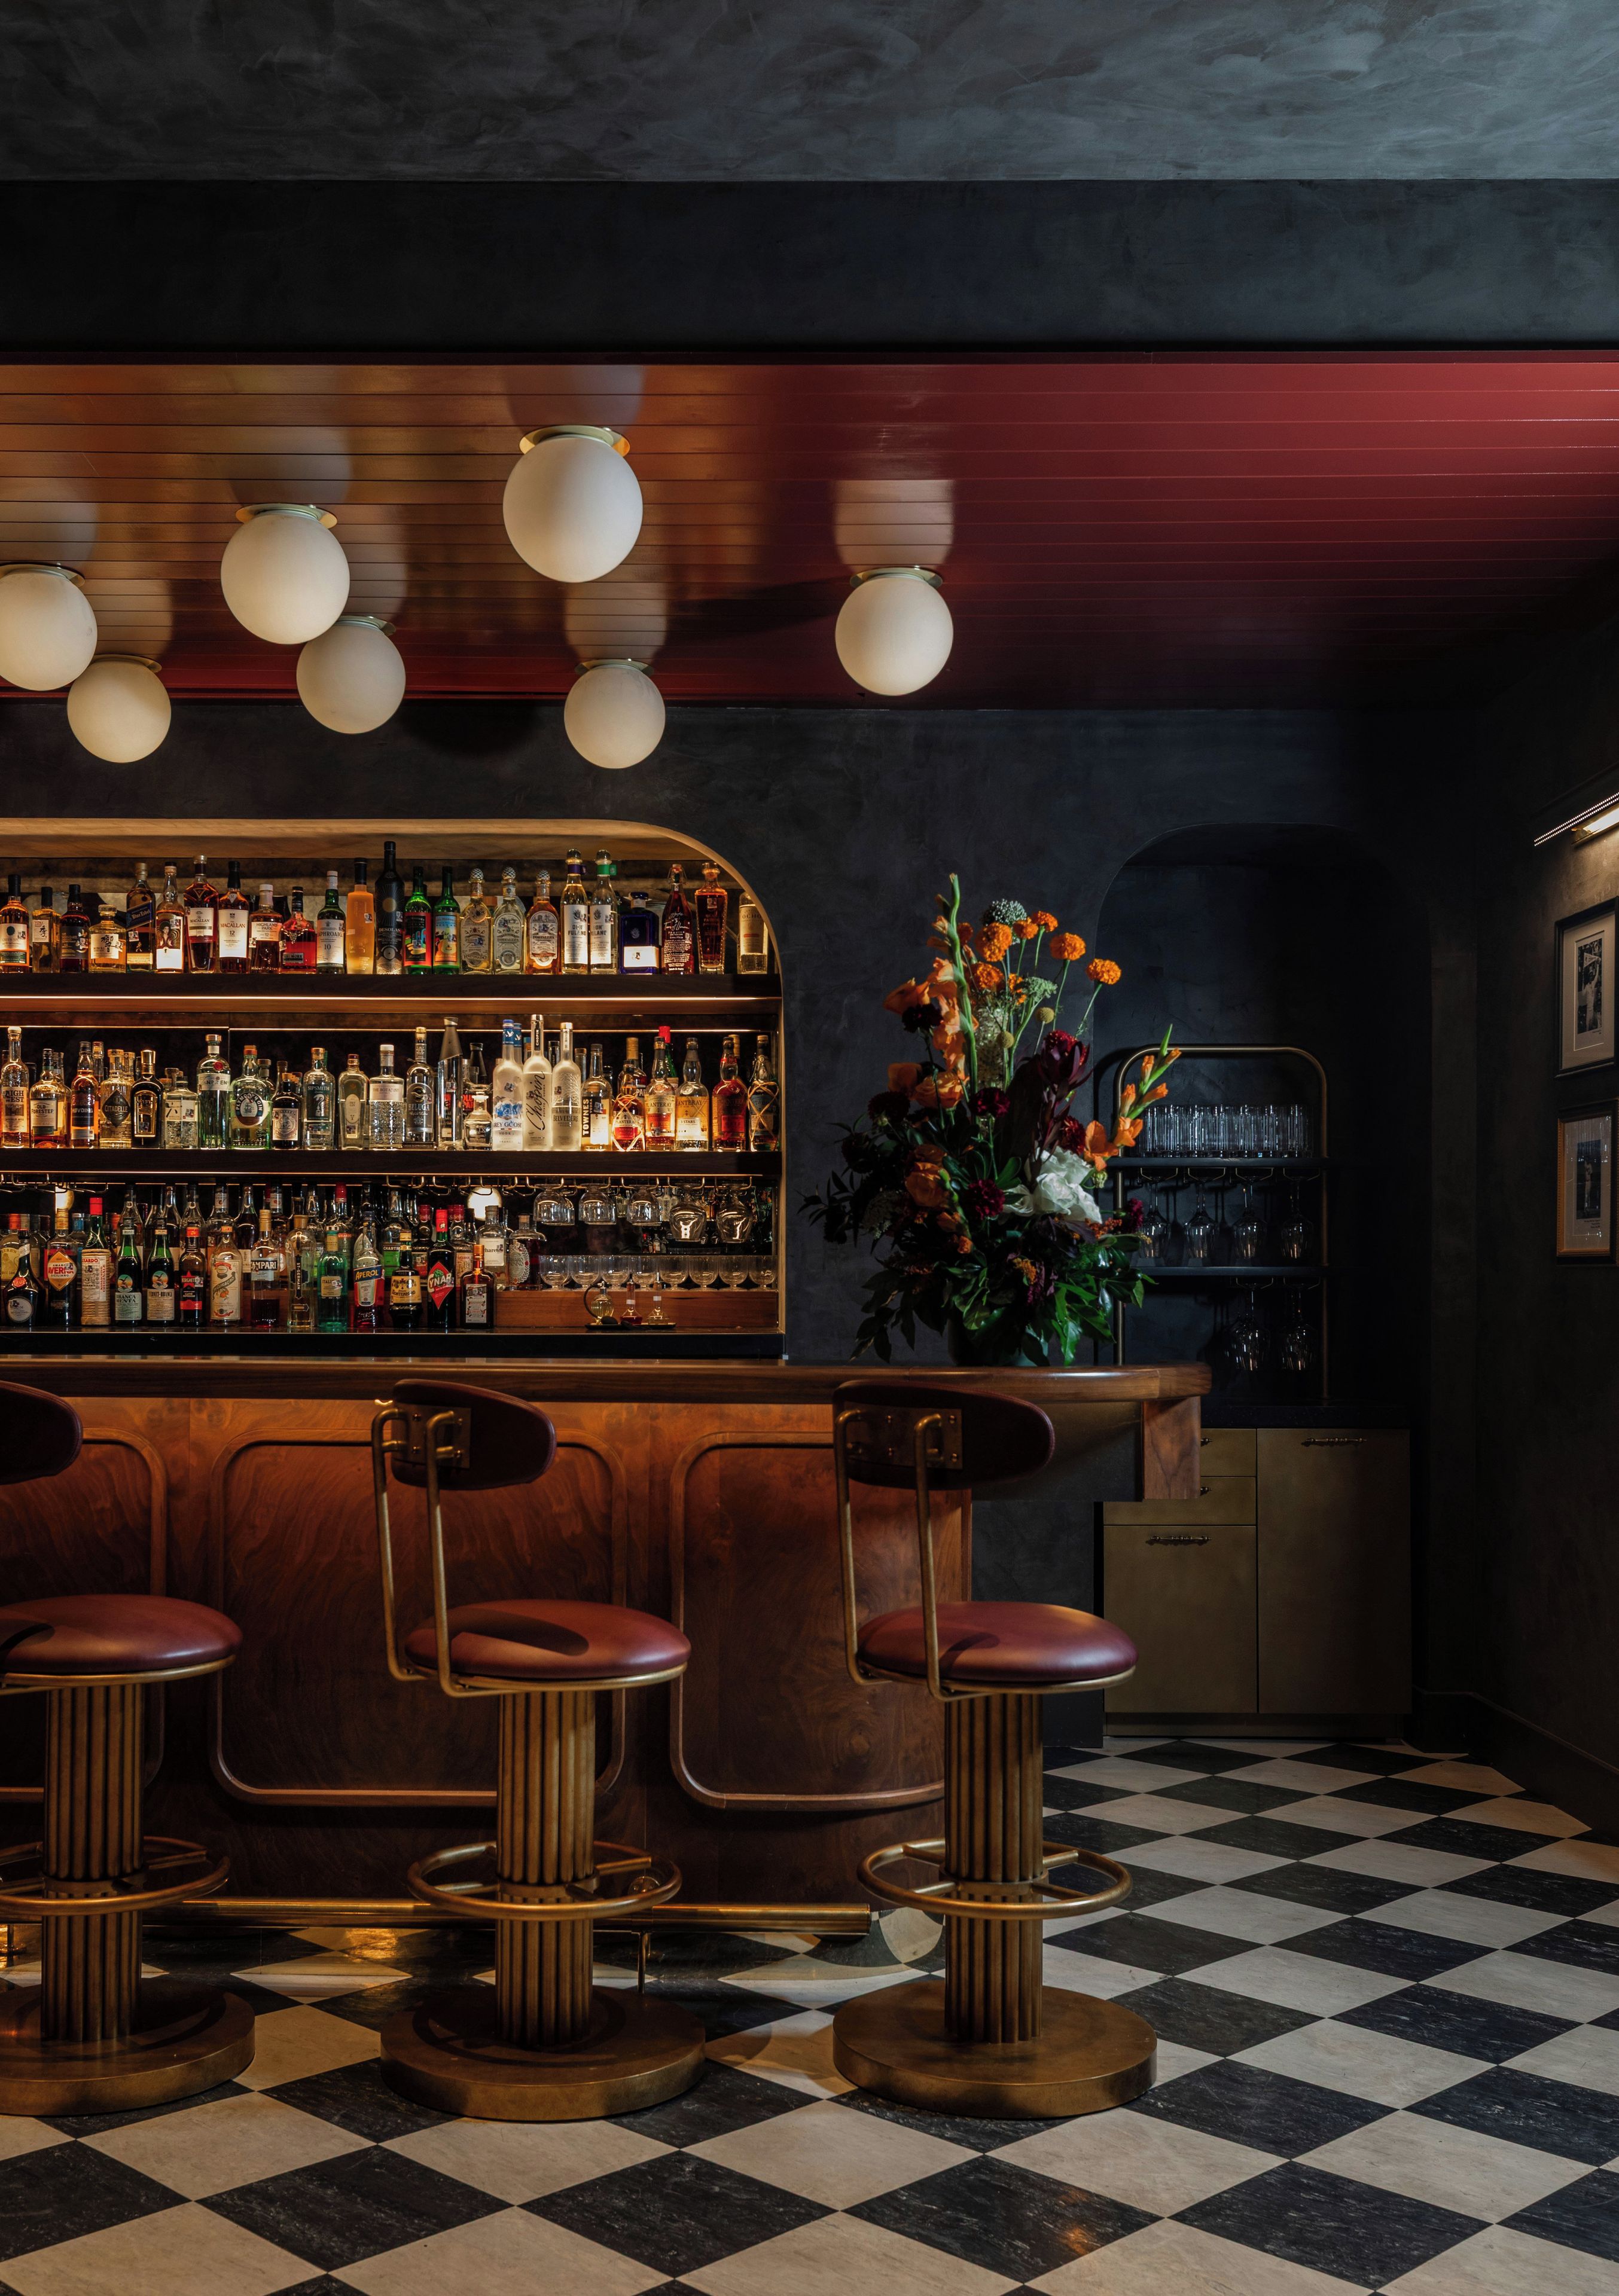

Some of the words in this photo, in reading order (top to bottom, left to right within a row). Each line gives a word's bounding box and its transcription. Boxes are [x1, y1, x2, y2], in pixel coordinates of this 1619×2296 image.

[236, 1092, 258, 1110] PLYMOUTH
[526, 1071, 550, 1131] Chopin
[355, 1269, 379, 1280] APEROL
